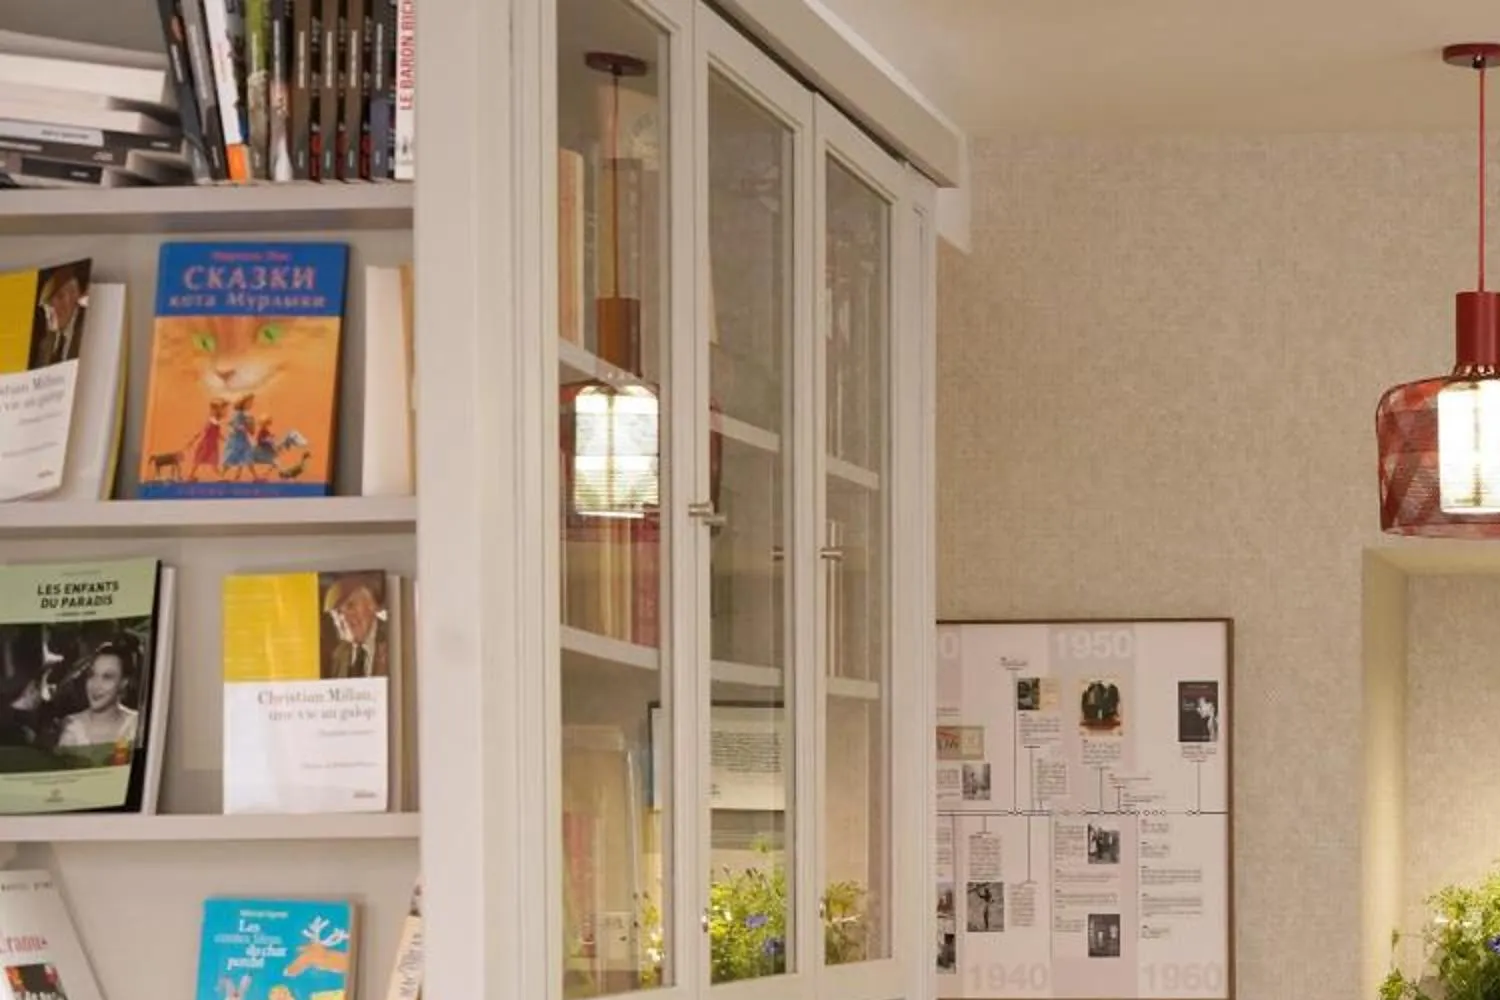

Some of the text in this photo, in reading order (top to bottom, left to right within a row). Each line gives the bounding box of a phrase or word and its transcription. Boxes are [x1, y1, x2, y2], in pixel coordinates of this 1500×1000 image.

[183, 264, 316, 291] СКАЗКИ
[37, 581, 119, 597] LES ENFANTS
[41, 594, 113, 609] DU PARADIS
[1057, 630, 1133, 660] 1950
